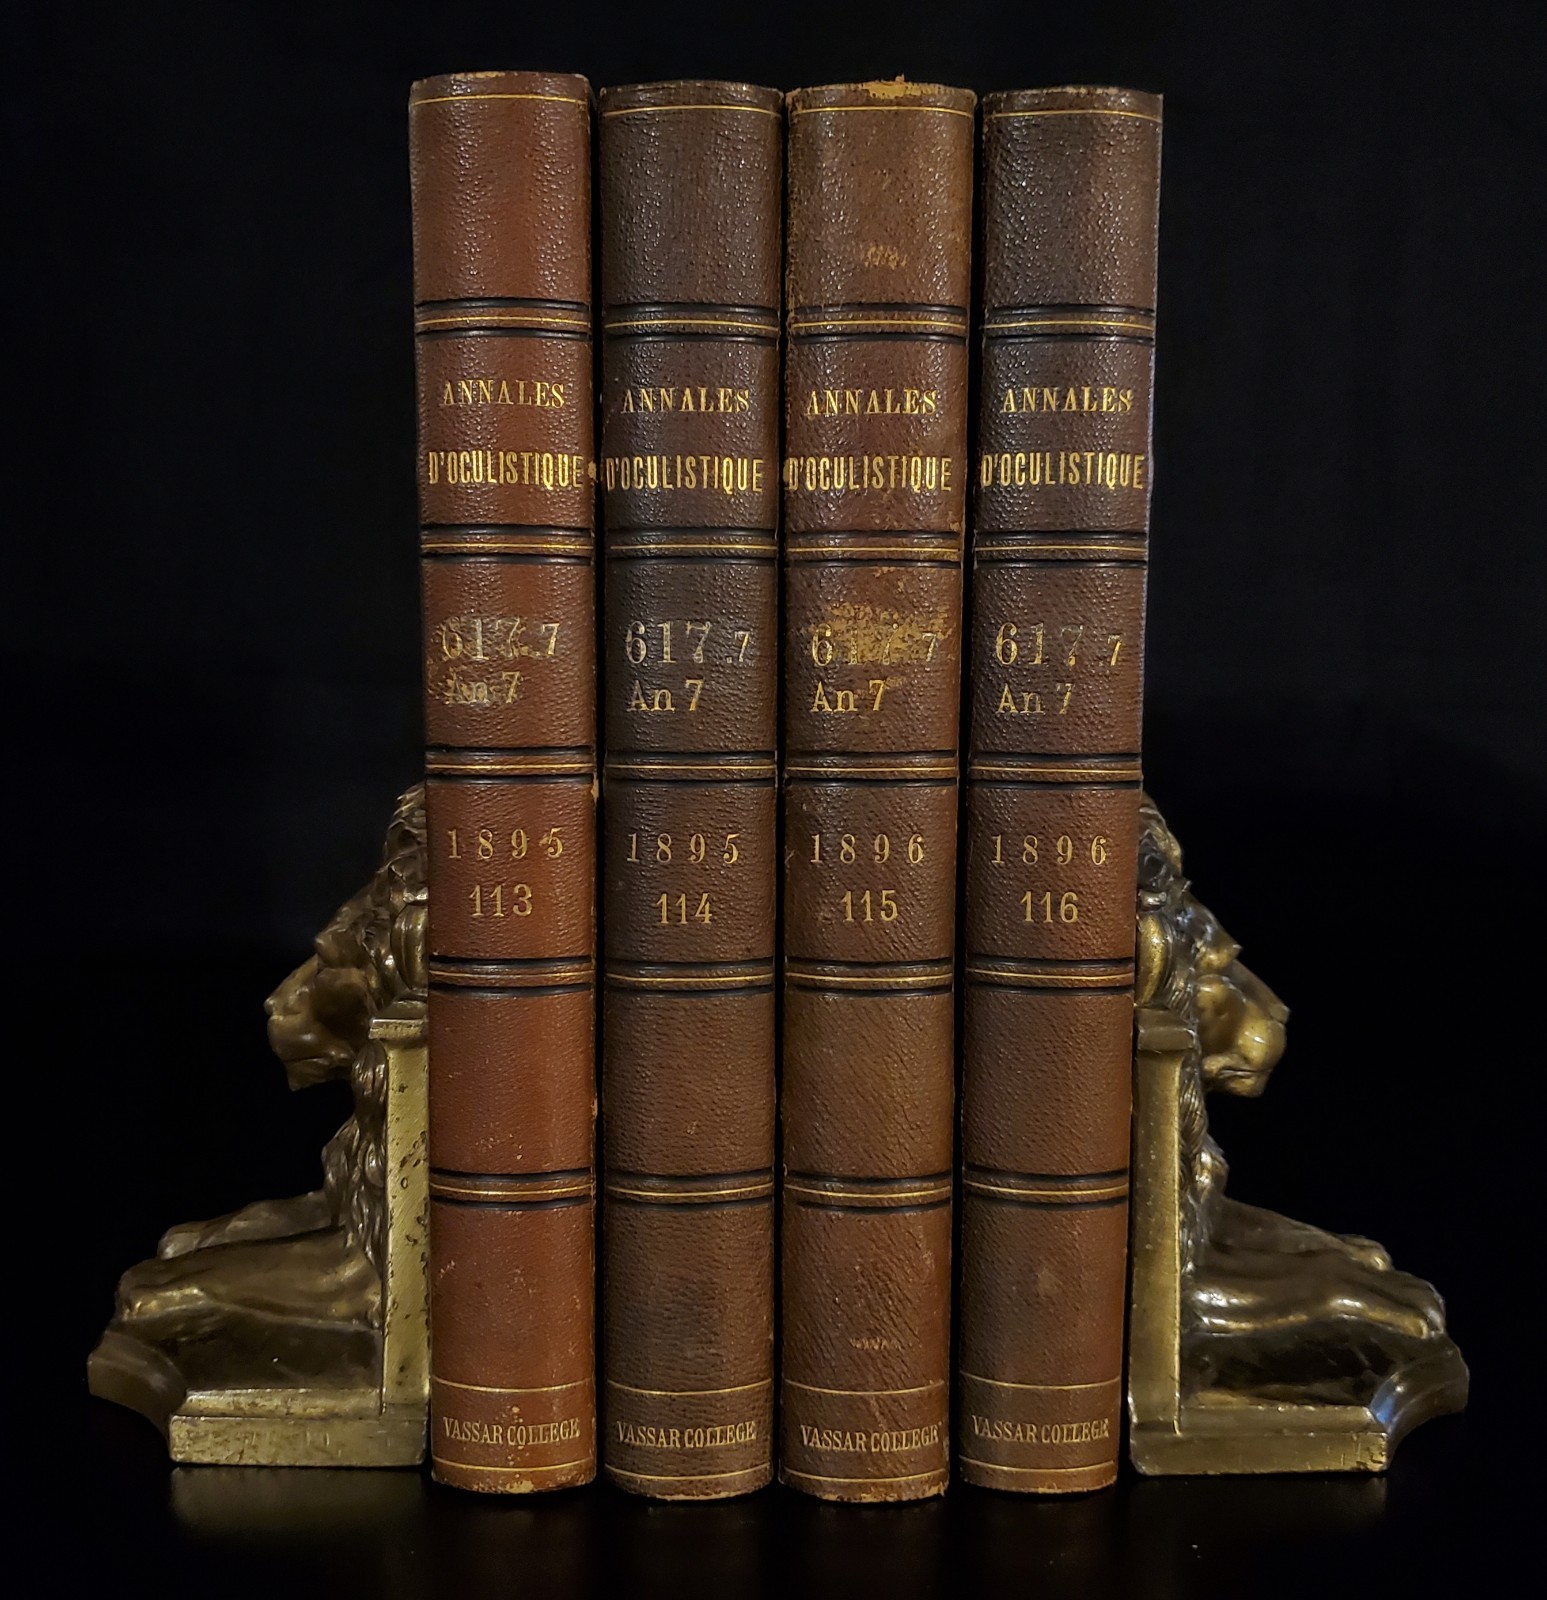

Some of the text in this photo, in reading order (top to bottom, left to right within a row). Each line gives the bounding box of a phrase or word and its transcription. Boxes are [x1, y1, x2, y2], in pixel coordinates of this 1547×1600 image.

[443, 380, 565, 408] ANNALES
[621, 387, 750, 414] ANNALES
[806, 387, 937, 415] ANNALES
[1000, 387, 1134, 413] ANNALES
[428, 451, 584, 489] D'OCULISTIQUE
[606, 455, 764, 494] D'OCULISTIQUE
[787, 456, 952, 493] D'OCULISTIQUE
[980, 452, 1145, 490] D'OCULISTIQUE
[502, 671, 521, 704] 7
[626, 679, 705, 712] An 7
[810, 679, 886, 713] An 7
[995, 682, 1075, 715] An 7
[448, 827, 564, 860] 1895
[626, 833, 740, 864] 1895
[810, 833, 925, 864] 1896
[992, 835, 1107, 866] 1896
[469, 884, 533, 917] 113
[656, 893, 713, 924] 114
[841, 890, 899, 923] 115
[1020, 892, 1079, 923] 116
[443, 1416, 581, 1446] VASSAR COLLEGE
[616, 1421, 757, 1449] VASSAR COLLEGE
[800, 1424, 940, 1453] VASSAR COLLEGE
[971, 1415, 1110, 1444] VASSAR COLLEGE
